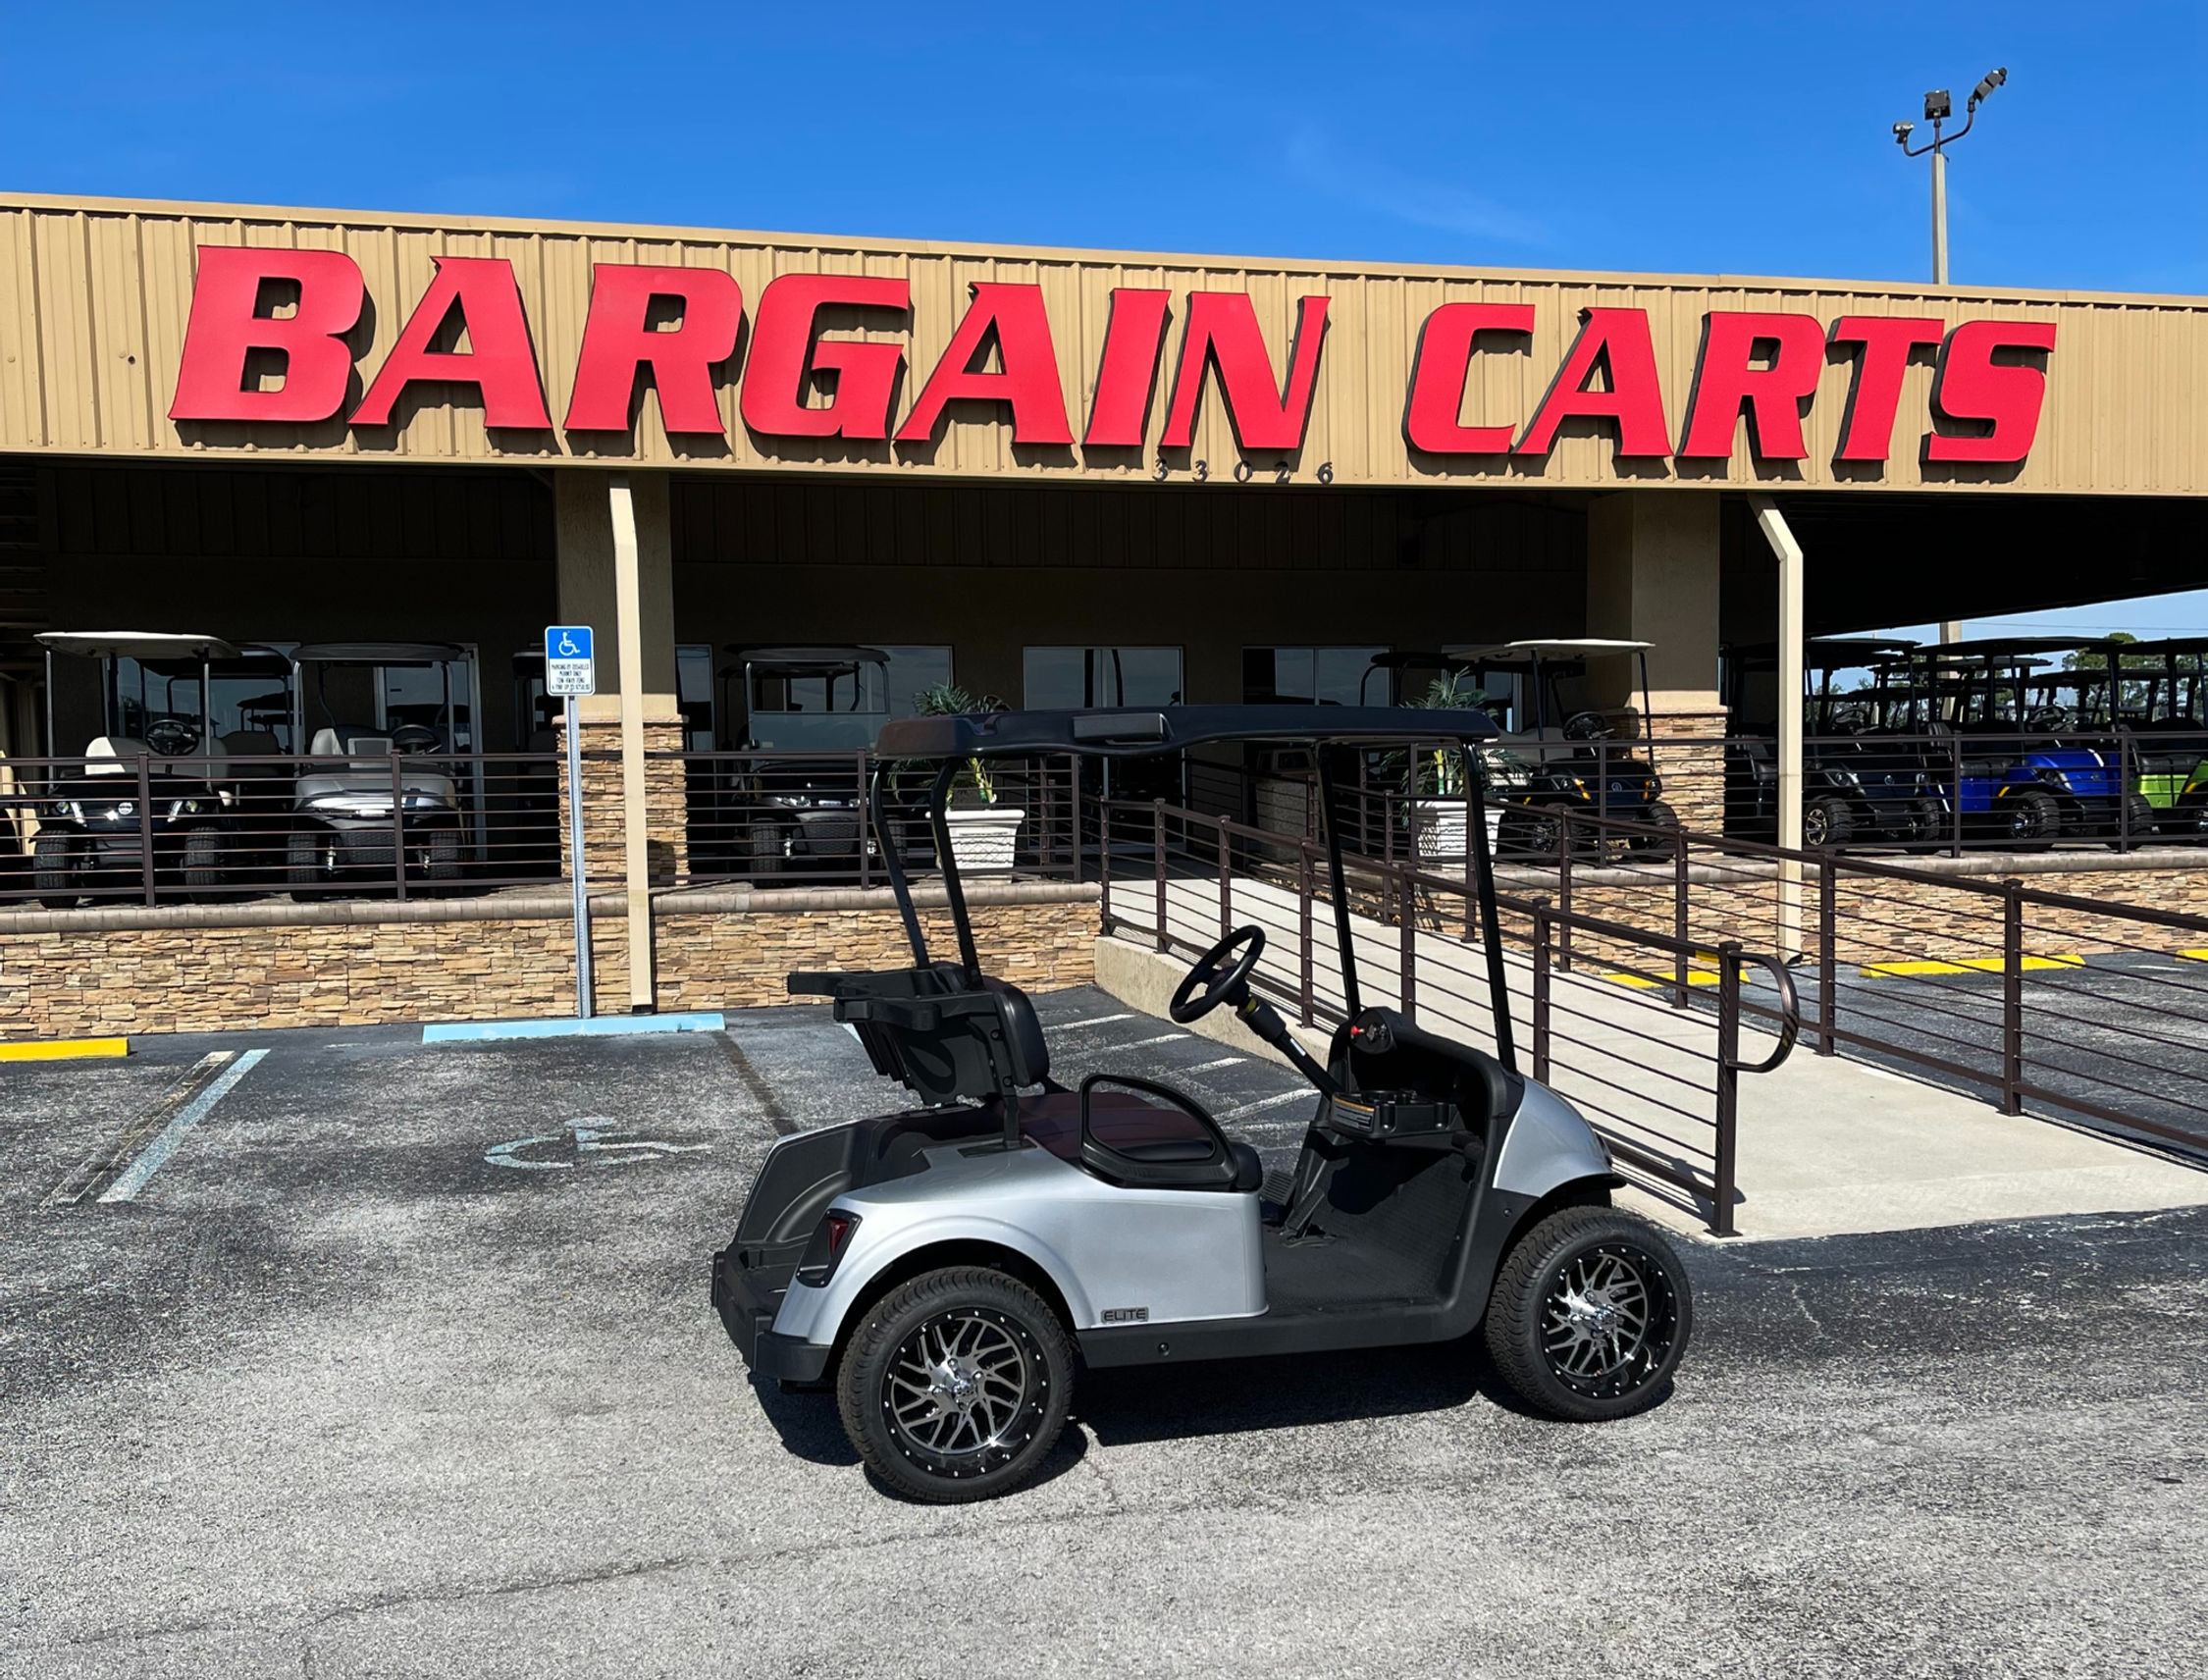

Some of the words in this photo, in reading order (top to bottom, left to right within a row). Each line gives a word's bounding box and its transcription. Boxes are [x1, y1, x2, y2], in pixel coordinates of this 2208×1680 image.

[169, 244, 1332, 448] BARGAIN
[1407, 302, 2057, 462] CARTS
[1152, 458, 1335, 484] 33026
[1104, 1309, 1146, 1321] ELITE
